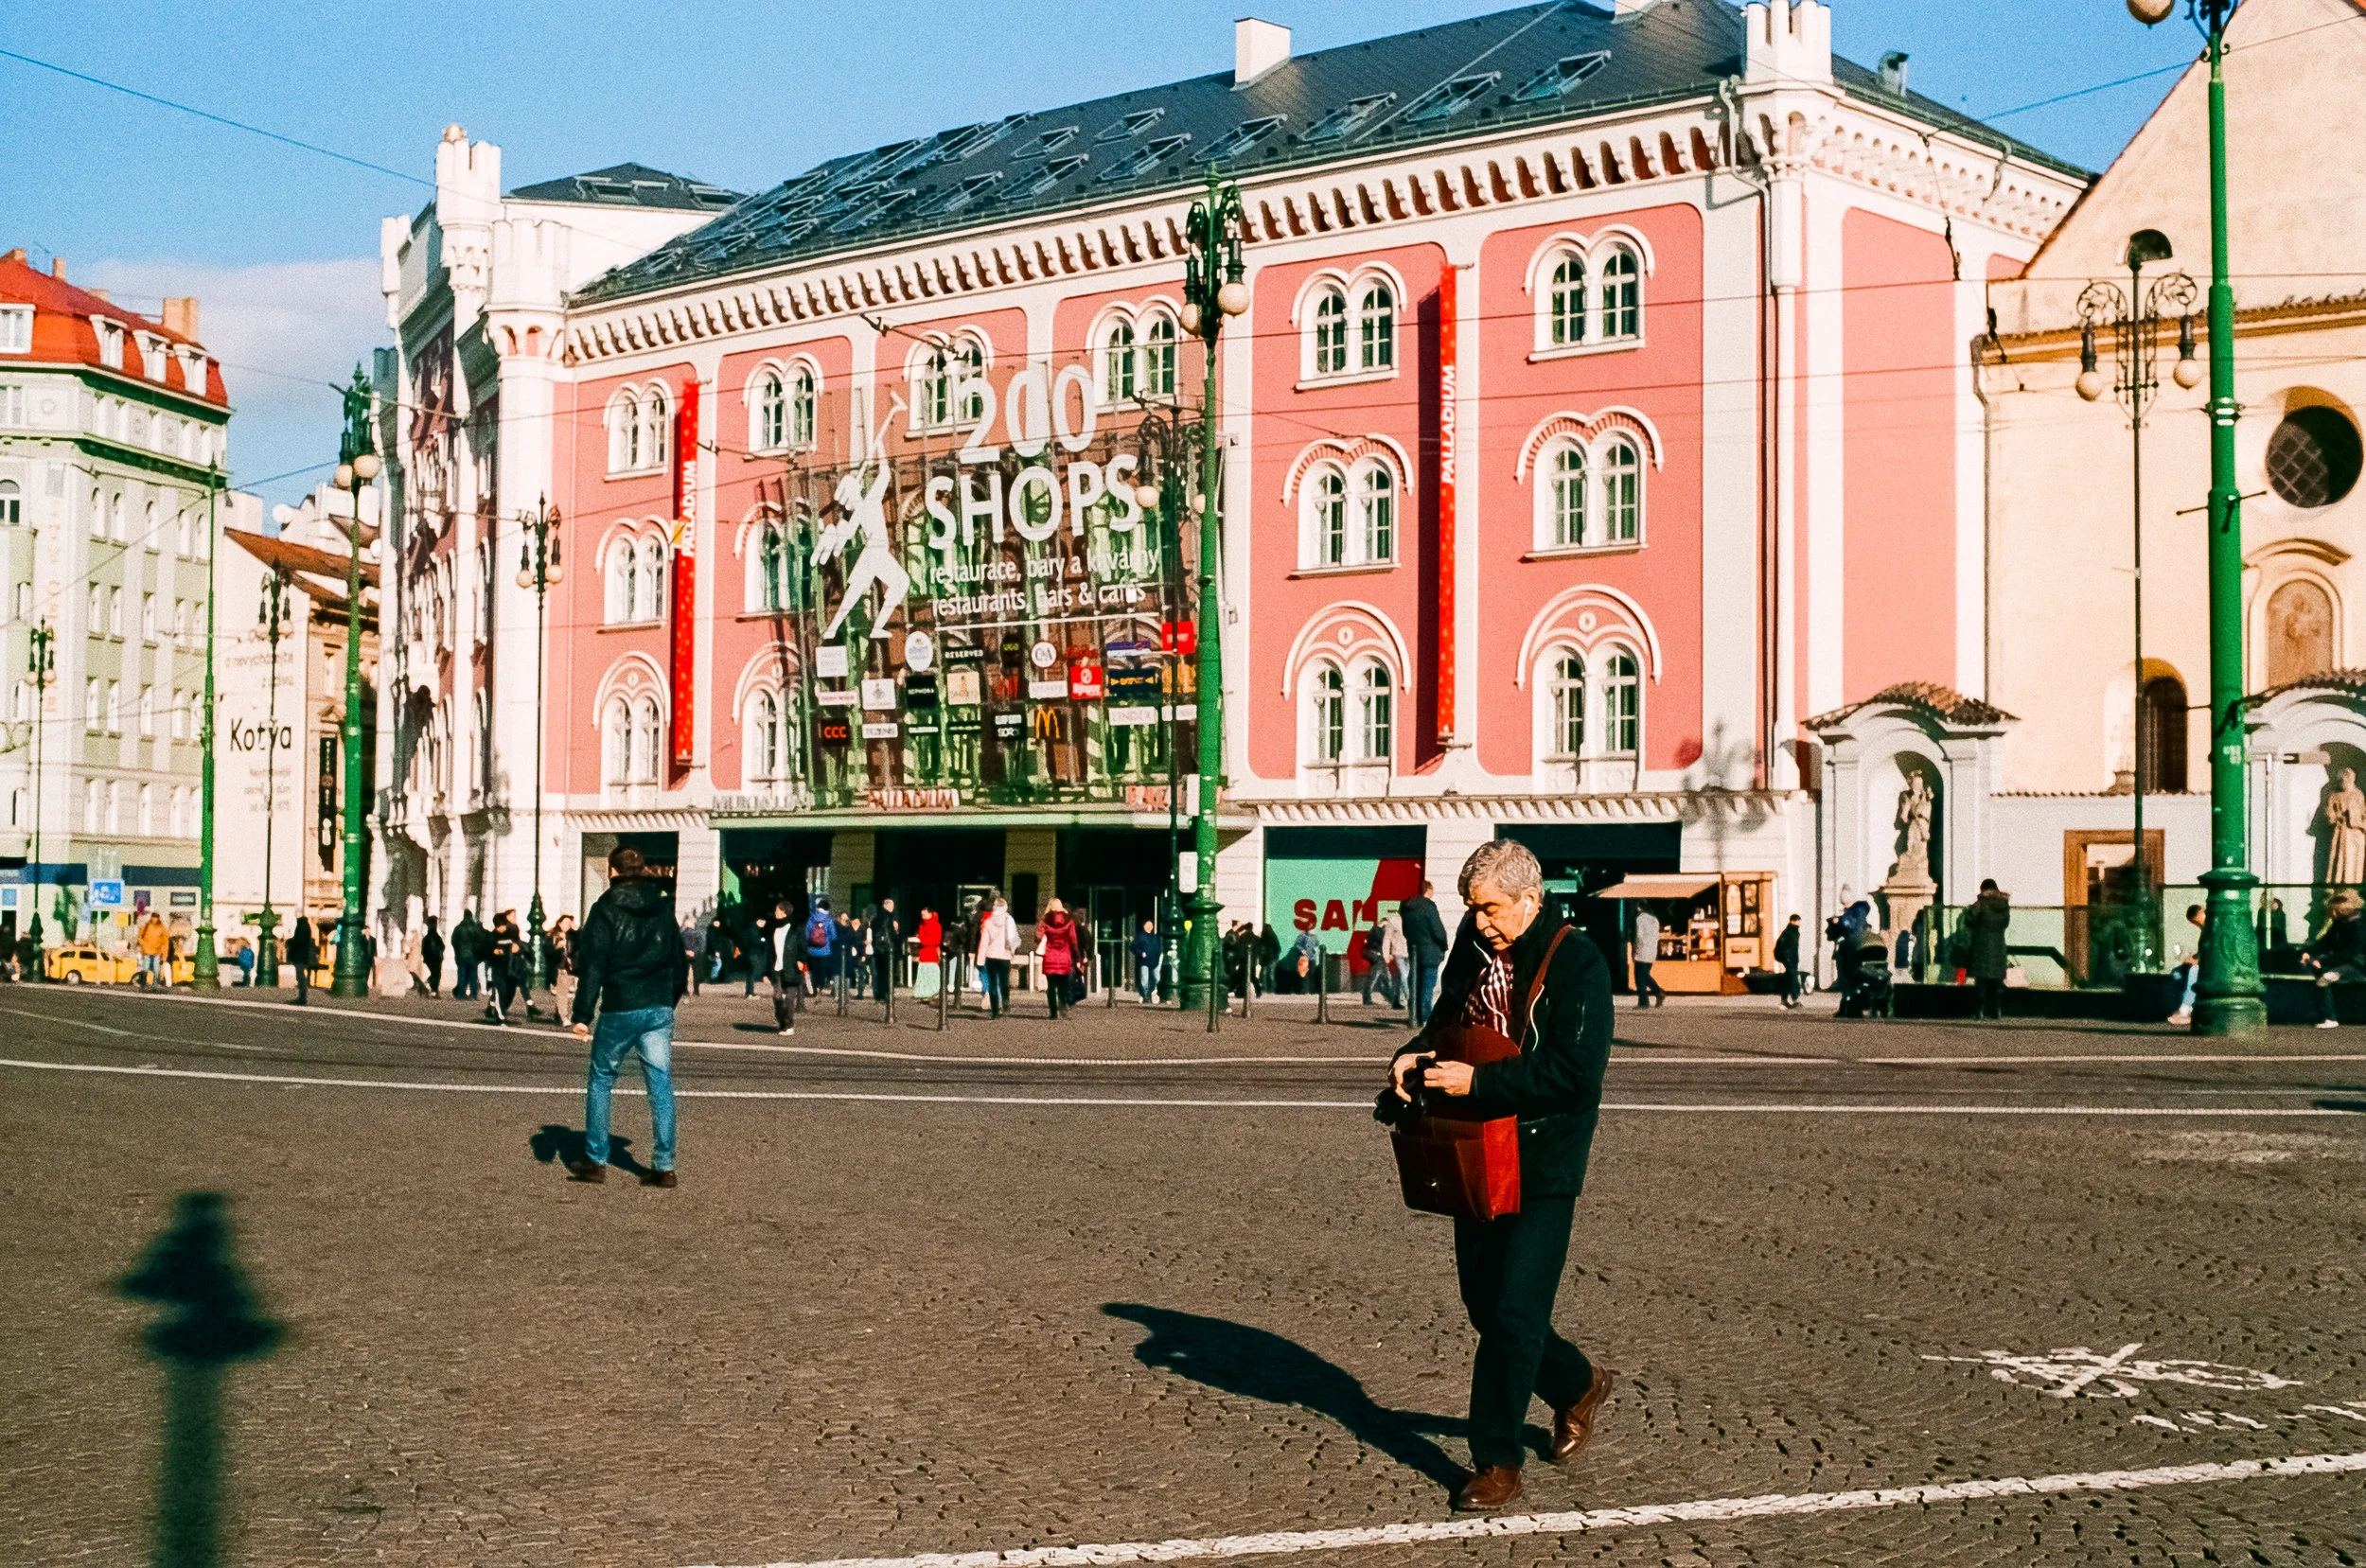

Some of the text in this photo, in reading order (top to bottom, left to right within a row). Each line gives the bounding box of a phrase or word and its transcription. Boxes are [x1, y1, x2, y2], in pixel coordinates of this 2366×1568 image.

[1441, 364, 1456, 484] PALLADIUM
[681, 460, 697, 557] PALLADIUM
[924, 453, 1141, 550] SHOPS
[1078, 581, 1092, 606] &
[230, 717, 291, 752] Kotva
[823, 726, 847, 739] CCC
